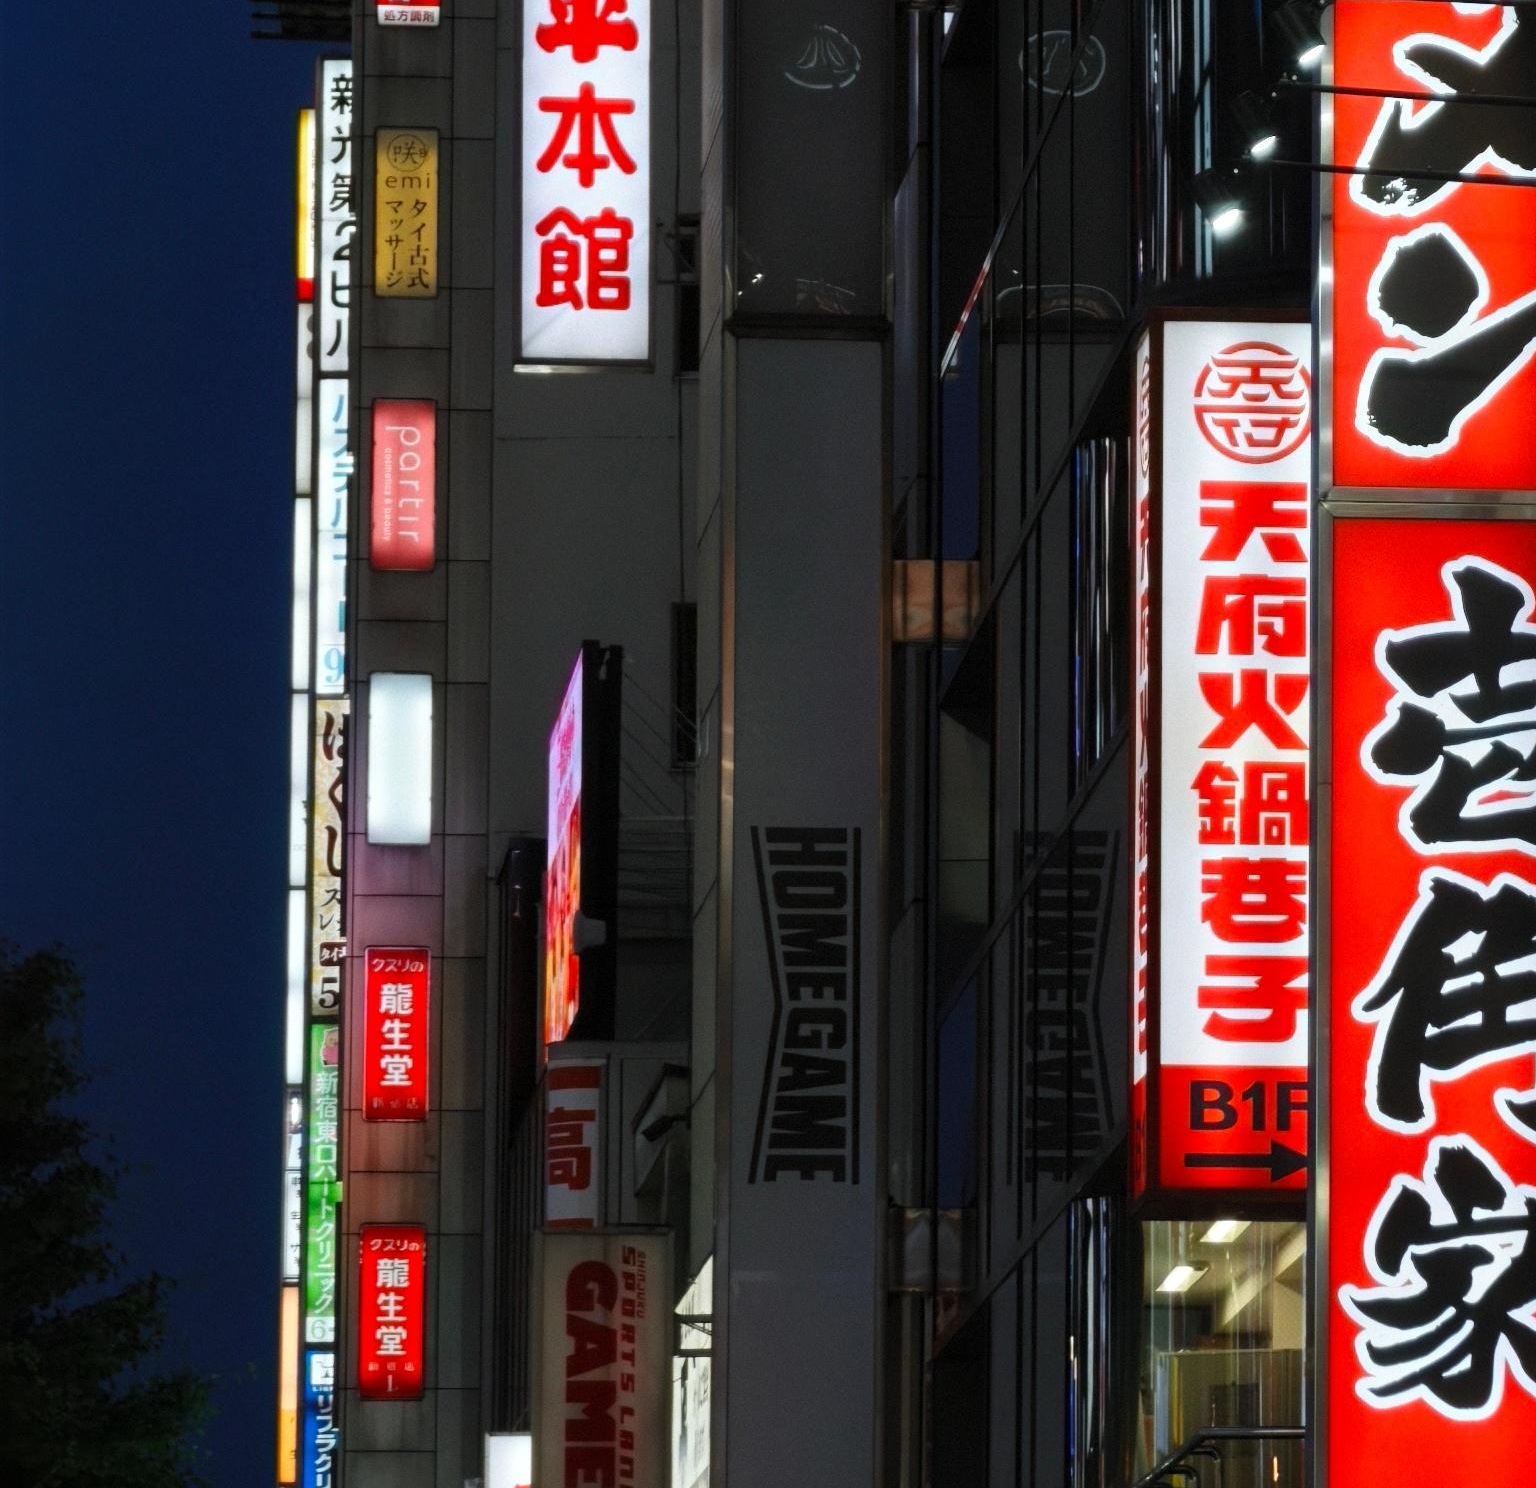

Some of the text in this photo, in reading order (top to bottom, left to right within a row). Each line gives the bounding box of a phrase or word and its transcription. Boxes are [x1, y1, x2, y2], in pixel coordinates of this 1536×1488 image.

[385, 172, 431, 190] emi
[385, 200, 404, 288] マッサージ
[407, 198, 431, 290] タイ古式
[371, 958, 425, 973] クスリの
[764, 827, 848, 1183] HOMEGAME
[379, 982, 414, 1087] 龍生堂
[369, 1238, 421, 1252] クスリの
[375, 1258, 411, 1357] 龍生堂
[620, 1245, 636, 1392] SPORTS
